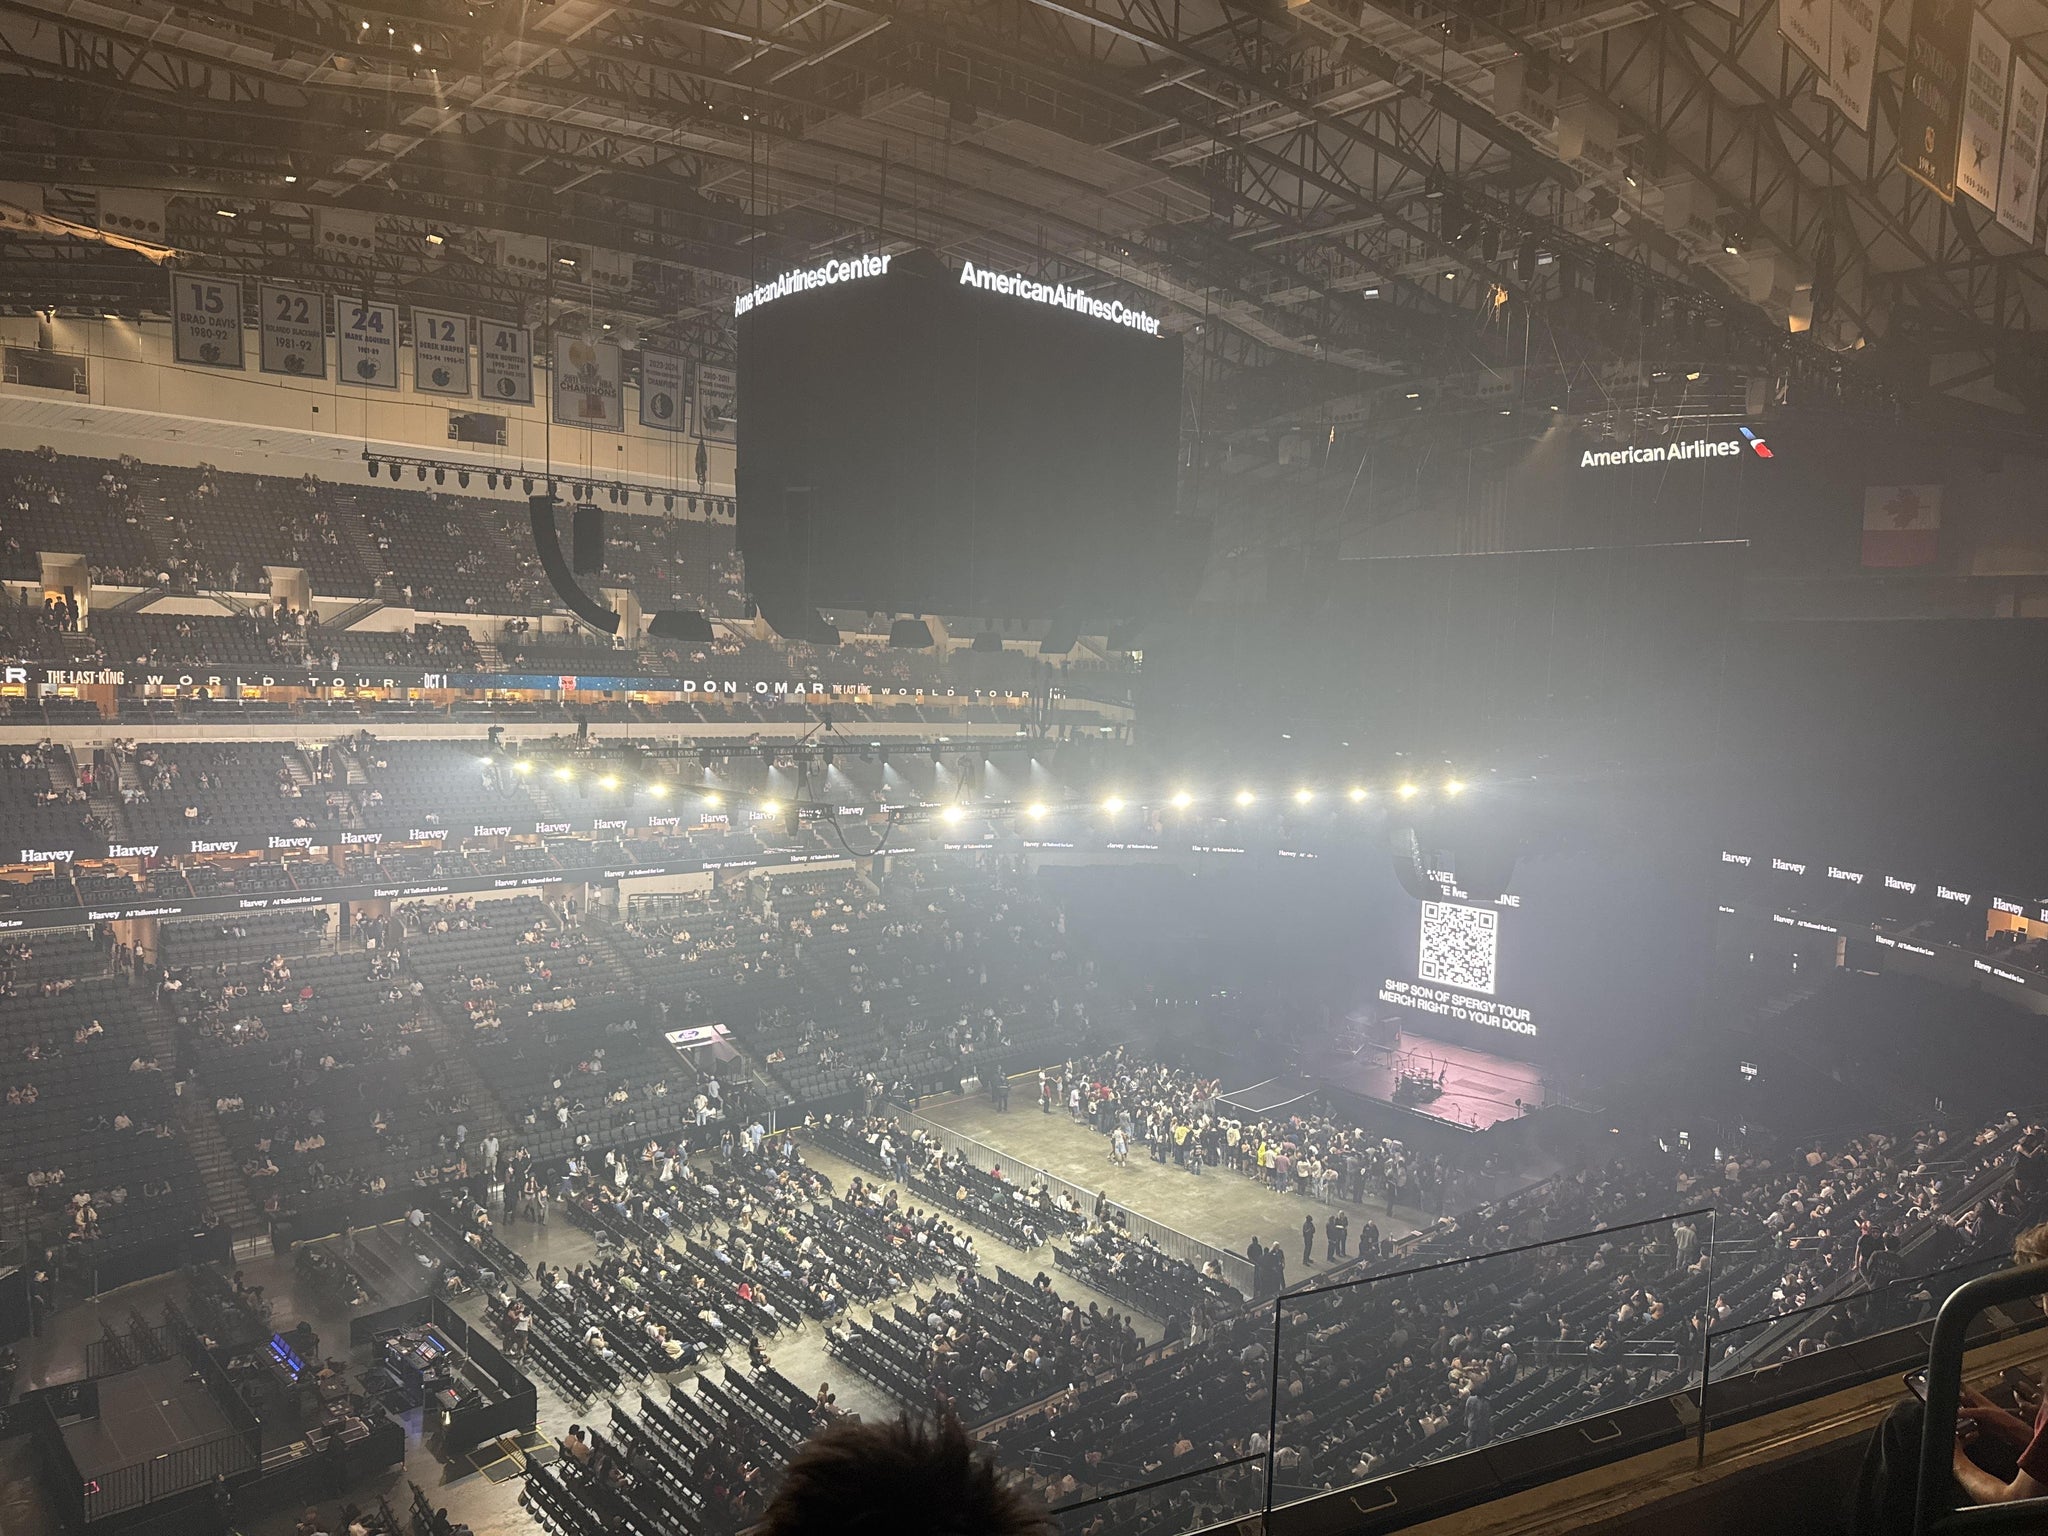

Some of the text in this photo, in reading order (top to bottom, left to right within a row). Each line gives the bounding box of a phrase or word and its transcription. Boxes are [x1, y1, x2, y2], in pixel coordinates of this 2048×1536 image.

[190, 284, 225, 314] 15
[959, 260, 1160, 336] AmericanAirlinesCenter
[276, 294, 310, 325] 22
[180, 313, 237, 329] BRAD DAVIS
[352, 308, 384, 333] 24
[427, 318, 456, 342] 12
[190, 326, 228, 341] 1980-92
[494, 331, 518, 353] 41
[275, 337, 312, 351] 1981-92
[419, 341, 465, 354] DEREK HARPER
[560, 382, 617, 399] CHAMPIONS
[598, 380, 613, 390] NBA
[1580, 439, 1741, 468] American Airlines
[47, 669, 66, 685] THE
[70, 670, 96, 685] LAST
[98, 668, 125, 686] KING
[148, 675, 275, 687] WORLD
[308, 677, 395, 688] TOUR
[424, 673, 448, 690] OCT 1
[683, 680, 738, 693] DON
[755, 680, 824, 694] OMAR
[832, 684, 842, 695] THE
[843, 684, 857, 695] LAST
[881, 686, 955, 697] WORLD
[975, 689, 1030, 698] TOUR
[21, 849, 74, 863] Harvey
[108, 844, 159, 858] Harvey
[191, 840, 238, 853] Harvey
[268, 836, 313, 848] Harvey
[341, 832, 383, 844] Harvey
[409, 828, 449, 840] Harvey
[474, 826, 512, 836] Harvey
[535, 822, 571, 833] Harvey
[594, 819, 628, 830] Harvey
[648, 816, 681, 827] Harvey
[700, 813, 729, 824] Harvey
[838, 806, 864, 816] Harvey
[374, 889, 400, 897] Harvey
[1772, 858, 1806, 875] Harvey
[1827, 866, 1864, 885] Harvey
[1884, 875, 1917, 894] Harvey
[1937, 885, 1972, 905] Harvey
[1993, 896, 2024, 917] Harvey
[240, 899, 268, 908] Harvey
[89, 911, 120, 920] Harvey
[134, 908, 159, 917] Tailored
[1385, 979, 1531, 1022] SHIP SON OF SPERGY TOUR
[1379, 989, 1537, 1036] MERCH RIGHT TO YOUR DOOR
